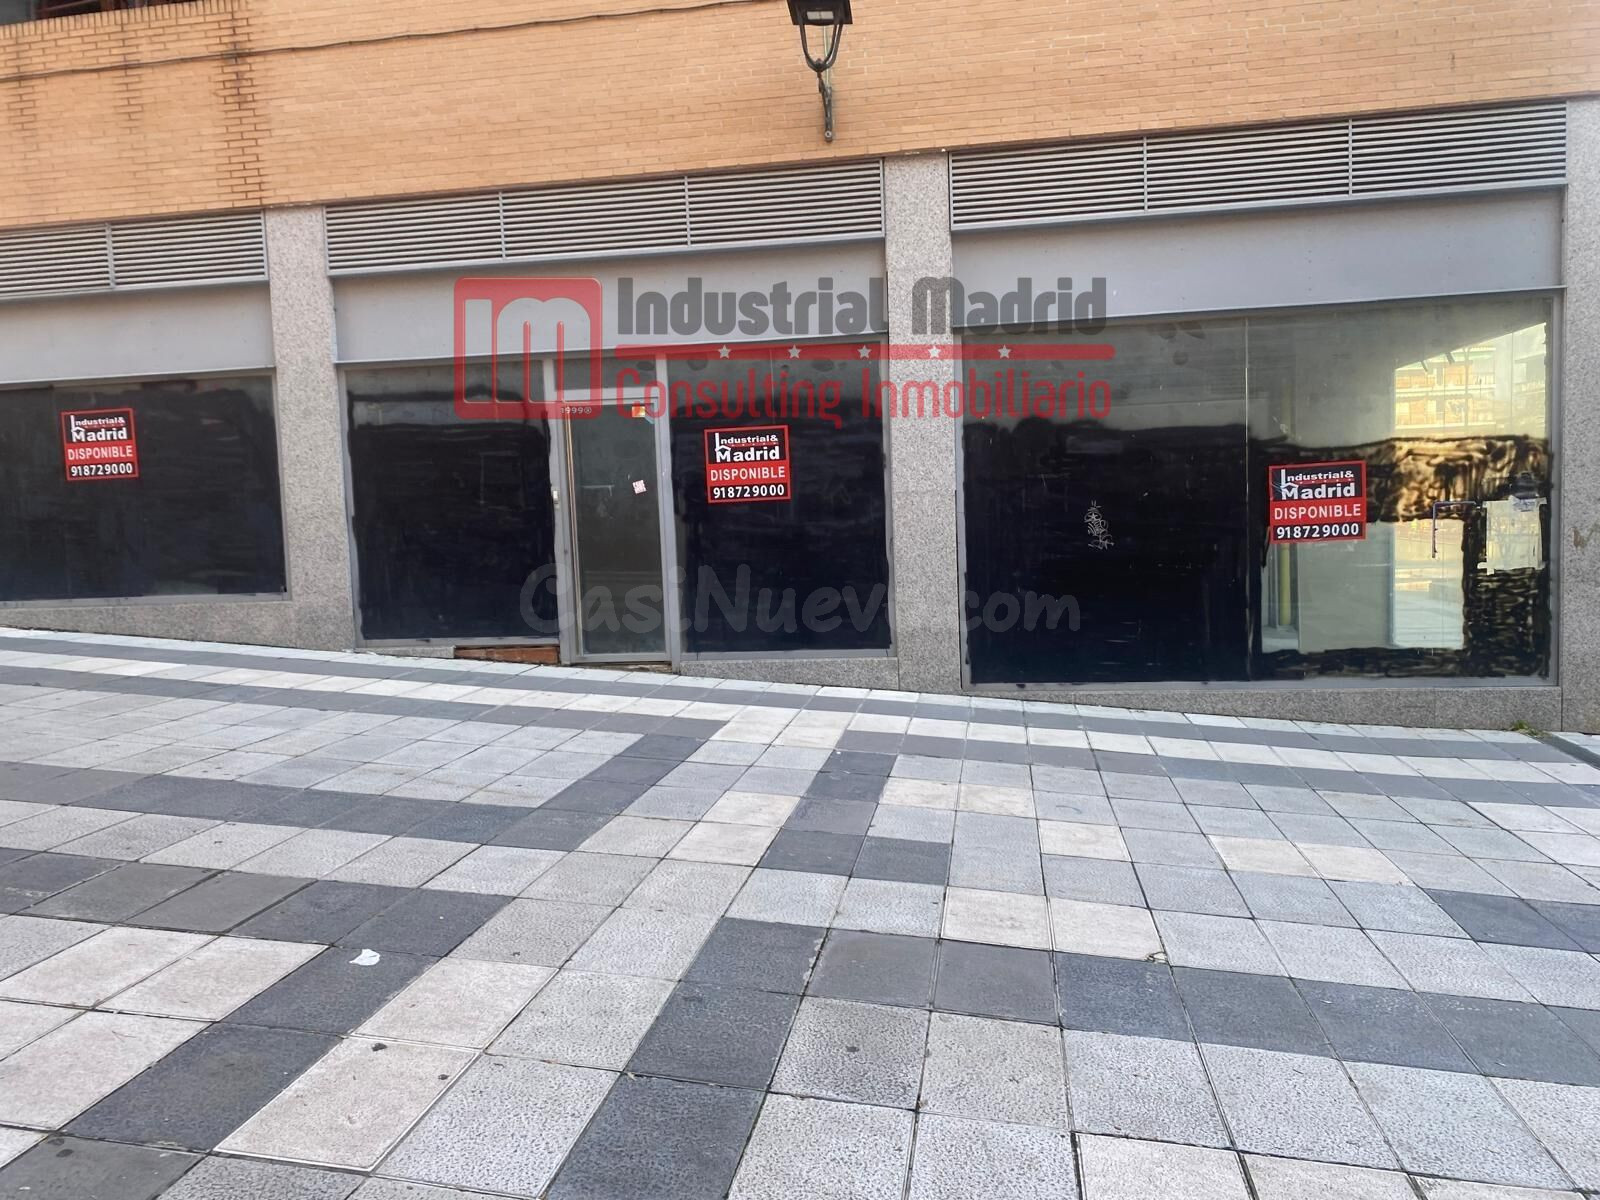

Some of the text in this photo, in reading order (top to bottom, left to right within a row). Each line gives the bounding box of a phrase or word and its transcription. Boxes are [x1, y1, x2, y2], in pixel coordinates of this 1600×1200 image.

[72, 427, 128, 442] Madrid
[67, 445, 133, 460] DISPONIBLE
[716, 445, 780, 462] Madrid
[71, 463, 133, 476] 918729000
[710, 466, 785, 481] DISPONIBLE
[713, 484, 785, 498] 918729000
[1281, 482, 1355, 500] Madrid
[1274, 504, 1361, 520] DISPONIBLE
